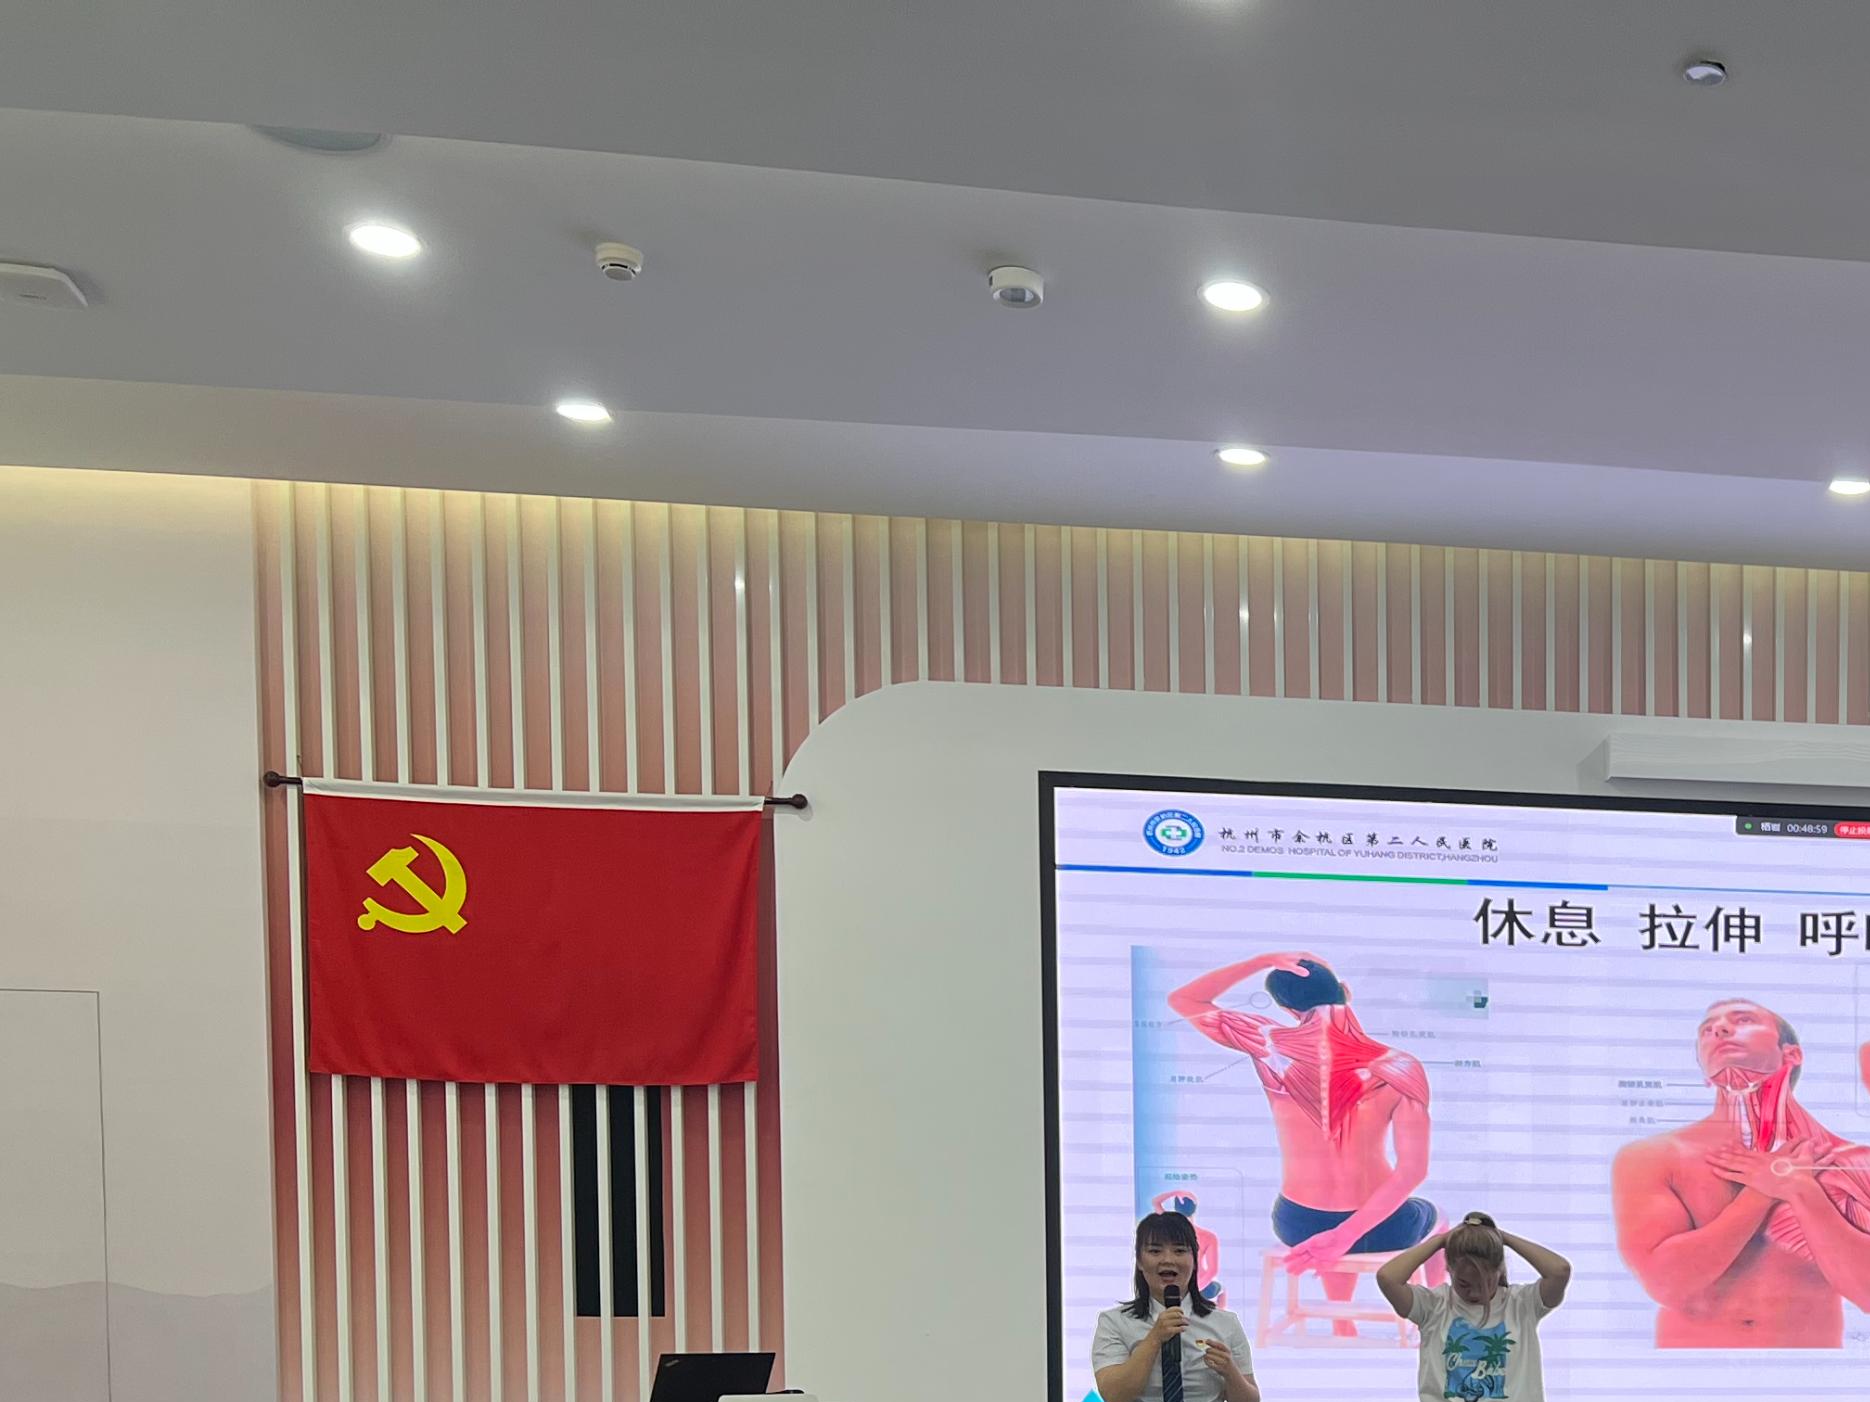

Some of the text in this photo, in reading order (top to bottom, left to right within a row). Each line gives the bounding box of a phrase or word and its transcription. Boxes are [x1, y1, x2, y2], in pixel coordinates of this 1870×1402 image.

[1218, 826, 1499, 851] 杭州市余杭区第二人民医院
[1221, 844, 1245, 854] NO.2
[1246, 845, 1284, 856] DEMOS
[1287, 846, 1336, 858] HOSPITAL
[1337, 848, 1352, 858] OF
[1354, 849, 1396, 860] YUHANG
[1472, 896, 1602, 949] 休息
[1638, 902, 1763, 955] 拉伸
